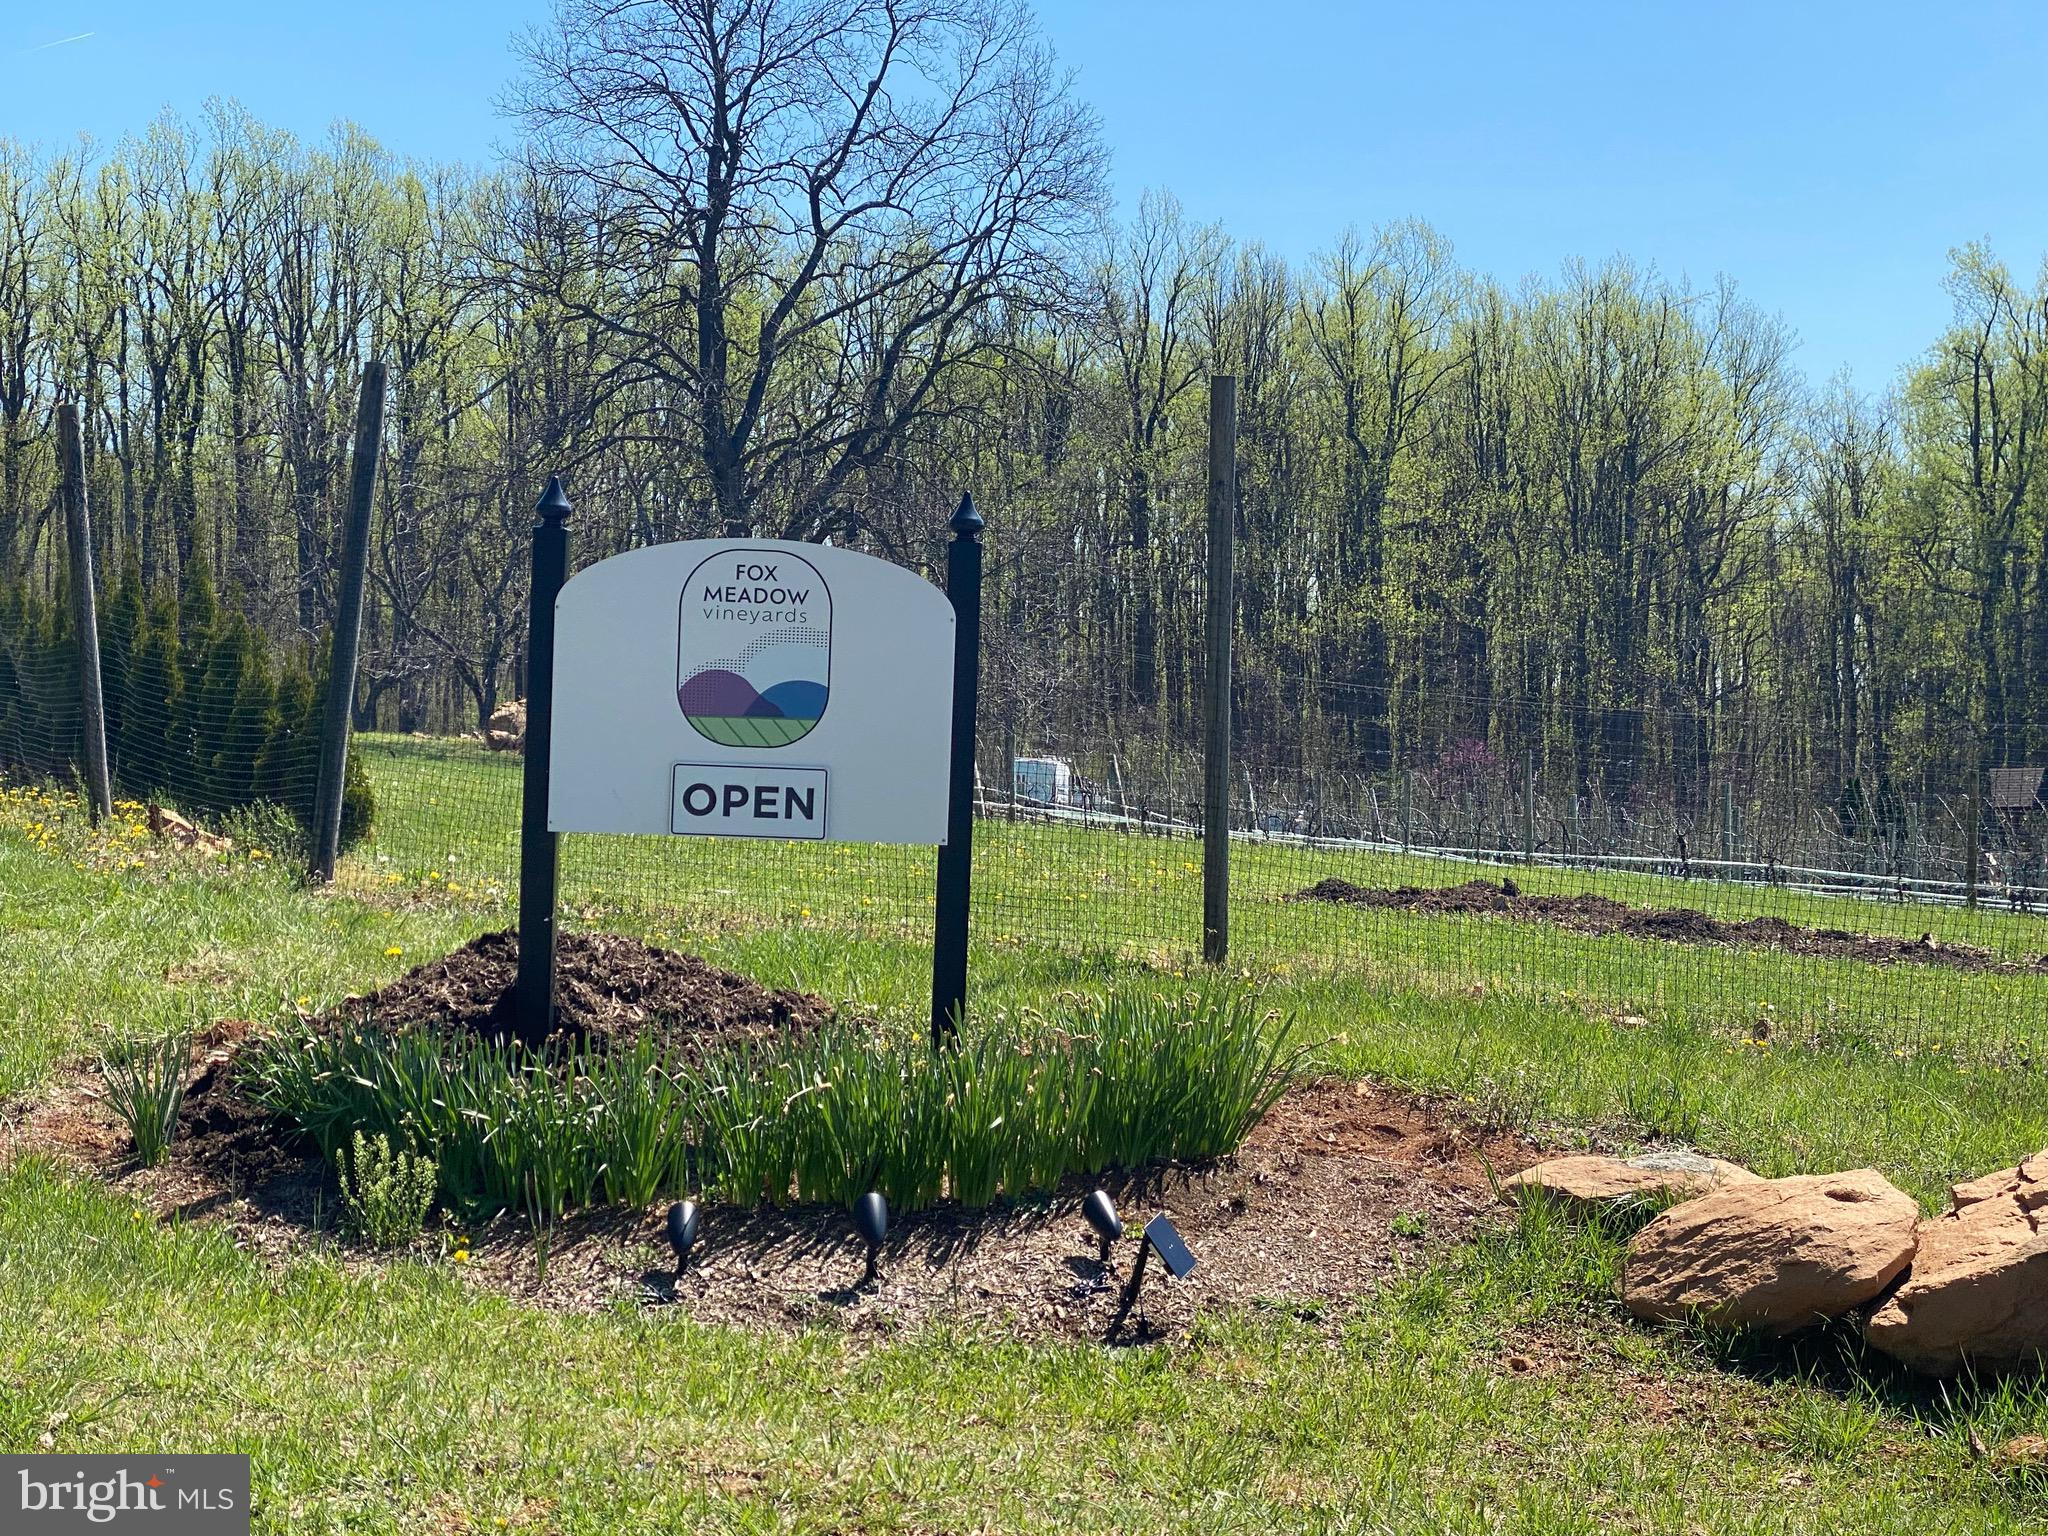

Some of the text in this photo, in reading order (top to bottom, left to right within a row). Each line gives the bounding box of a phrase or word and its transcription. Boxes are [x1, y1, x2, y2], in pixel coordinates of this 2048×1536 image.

[735, 564, 778, 582] FOX
[703, 586, 810, 605] MEADOW
[703, 605, 807, 625] vineyards
[682, 782, 815, 820] OPEN
